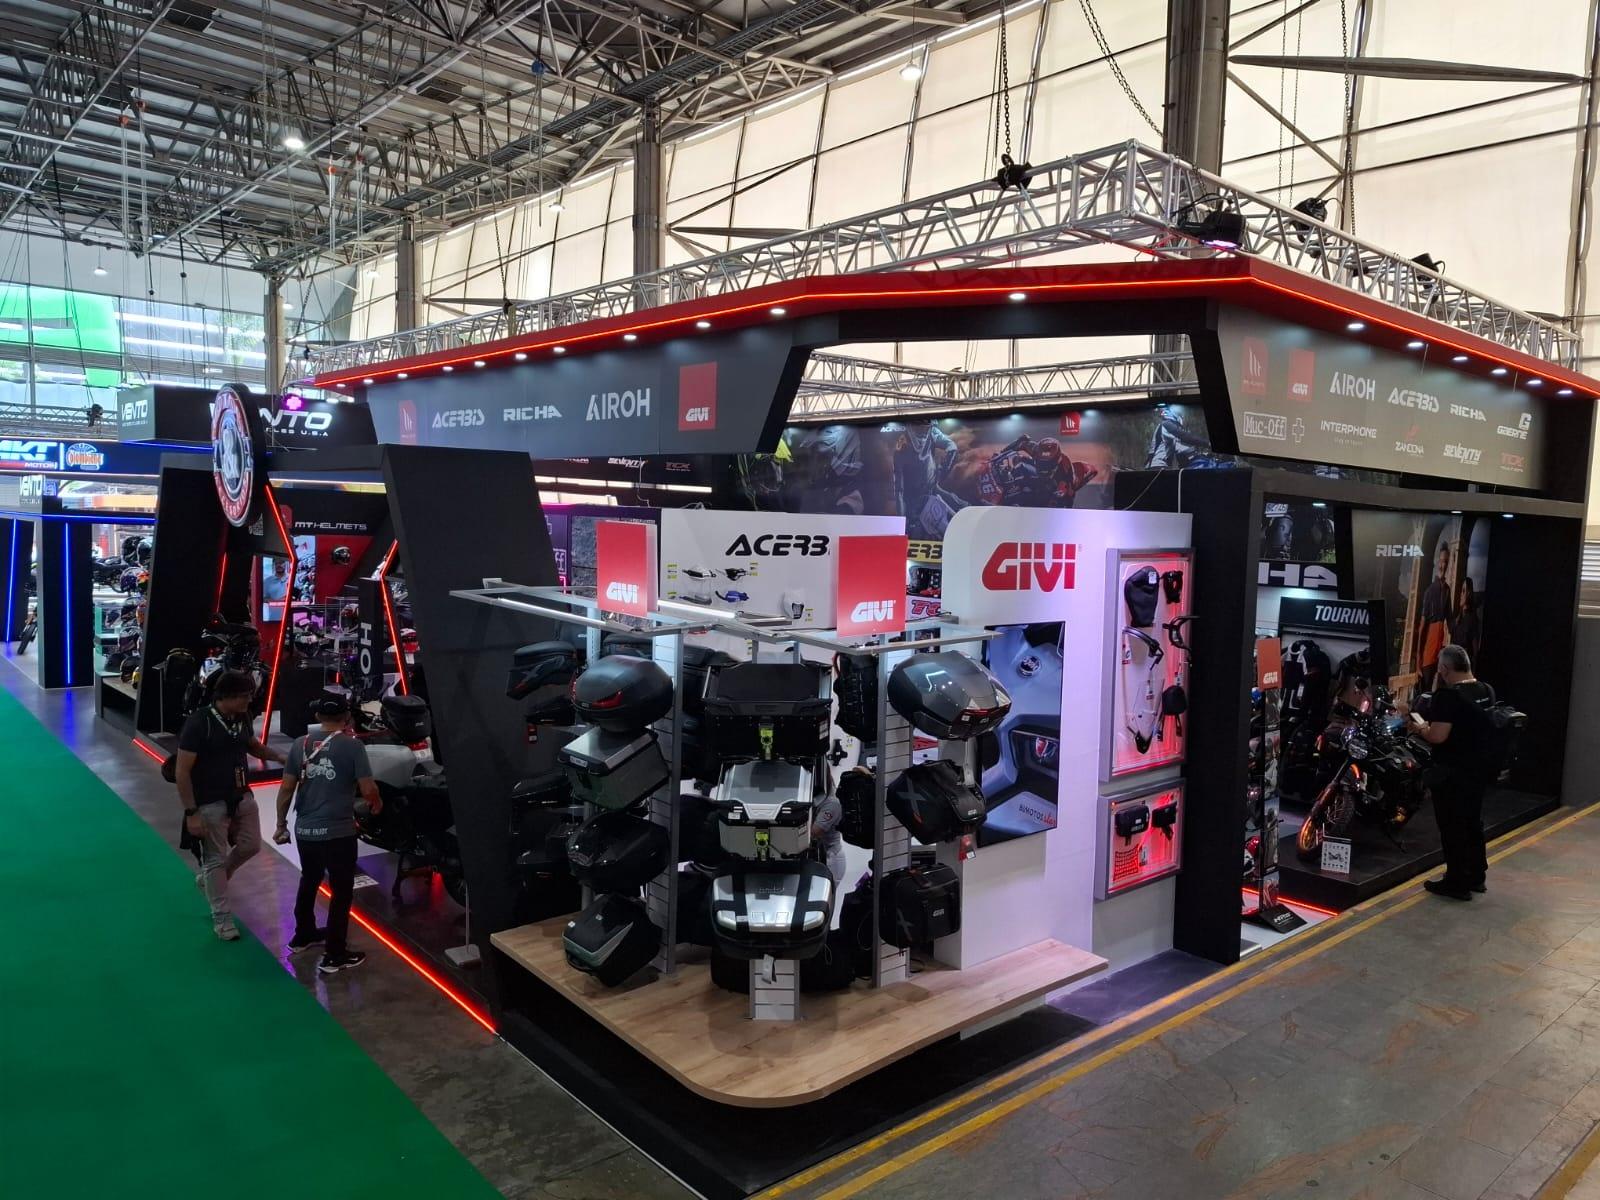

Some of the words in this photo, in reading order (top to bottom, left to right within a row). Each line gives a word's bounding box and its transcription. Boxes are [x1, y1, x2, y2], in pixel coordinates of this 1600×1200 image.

[1329, 371, 1376, 401] AIROH
[121, 400, 148, 420] VENTO
[586, 388, 651, 421] AIROH
[1387, 387, 1440, 413] ACERBIS
[432, 408, 485, 429] ACERBIS
[503, 405, 562, 422] RICHA
[685, 407, 709, 422] GIVI
[1449, 403, 1487, 422] RICHA
[1245, 416, 1285, 437] Muc-Off
[1320, 420, 1377, 439] INTERPHONE
[725, 533, 831, 557] ACERB
[1375, 544, 1425, 557] RICHA
[982, 541, 1076, 592] GIVI
[606, 582, 638, 604] GIVI
[850, 600, 896, 623] GIVI
[1262, 671, 1279, 685] GIVI
